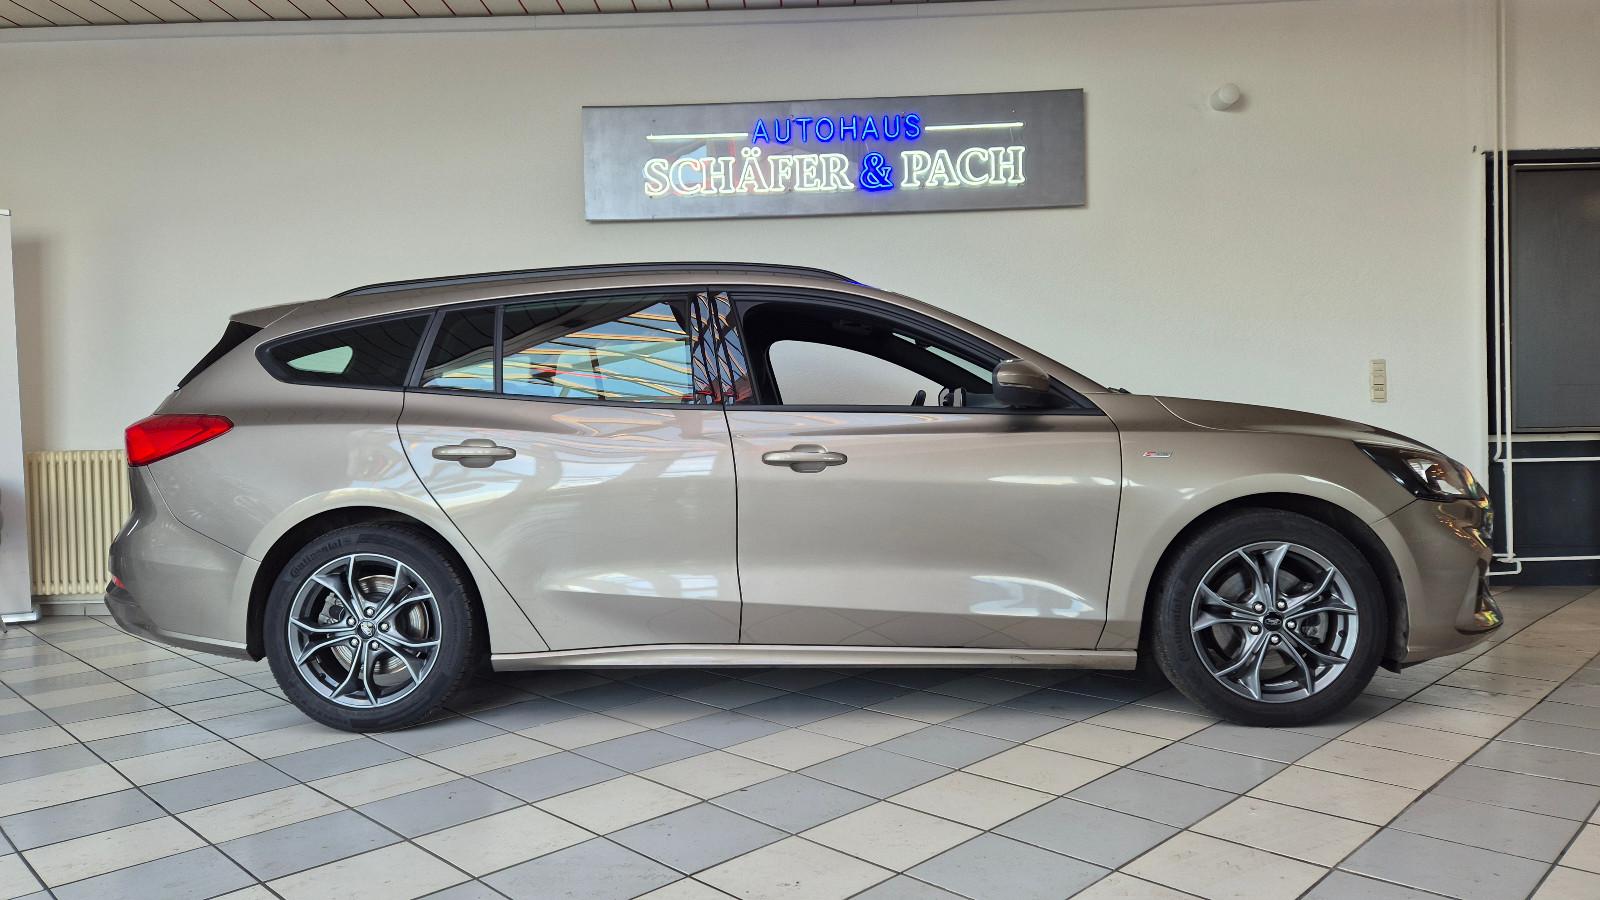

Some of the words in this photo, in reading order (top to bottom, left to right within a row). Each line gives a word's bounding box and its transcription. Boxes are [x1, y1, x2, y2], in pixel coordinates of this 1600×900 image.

[751, 112, 921, 144] AUTOHAUS
[643, 147, 854, 195] SCHÄFER
[859, 151, 895, 191] &
[901, 146, 1026, 187] PACH
